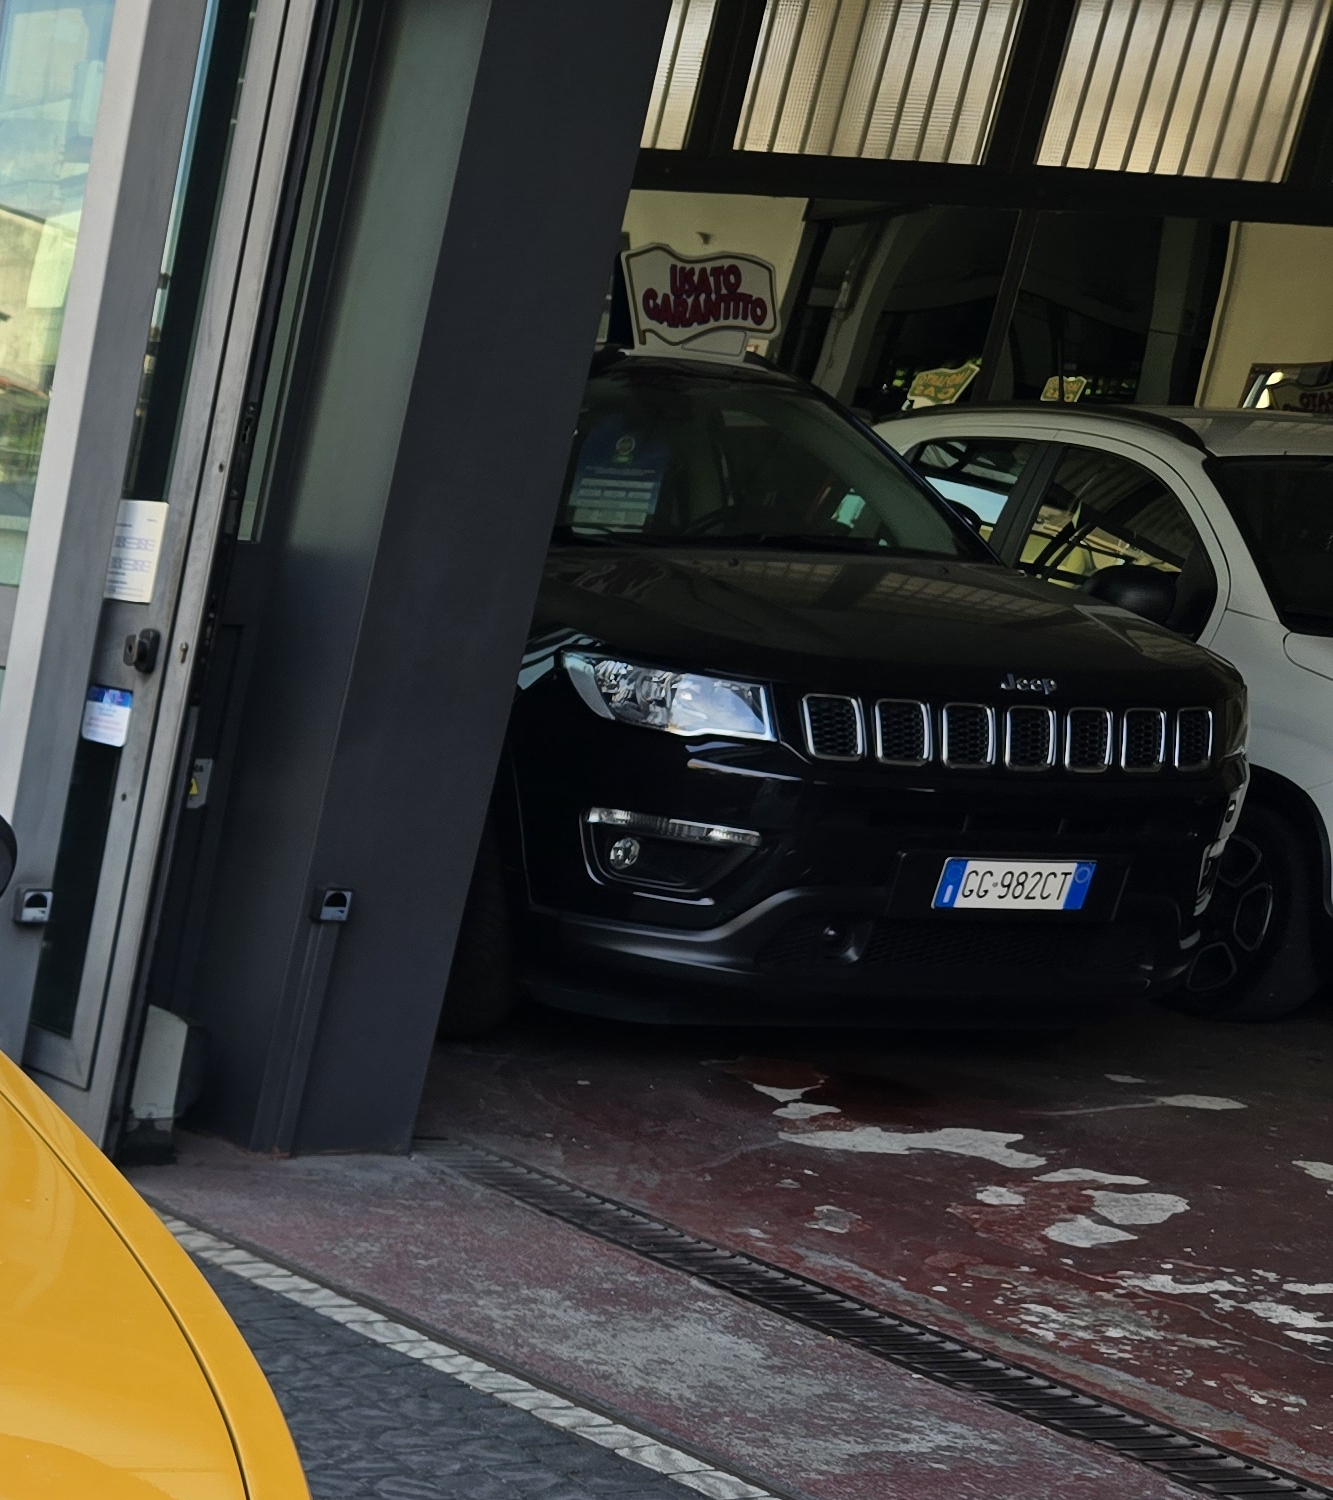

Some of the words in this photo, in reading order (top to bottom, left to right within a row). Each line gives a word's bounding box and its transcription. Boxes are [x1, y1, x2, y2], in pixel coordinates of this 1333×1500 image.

[669, 263, 743, 298] USATO
[642, 287, 768, 328] GARANTITO
[1000, 673, 1058, 696] Jeep
